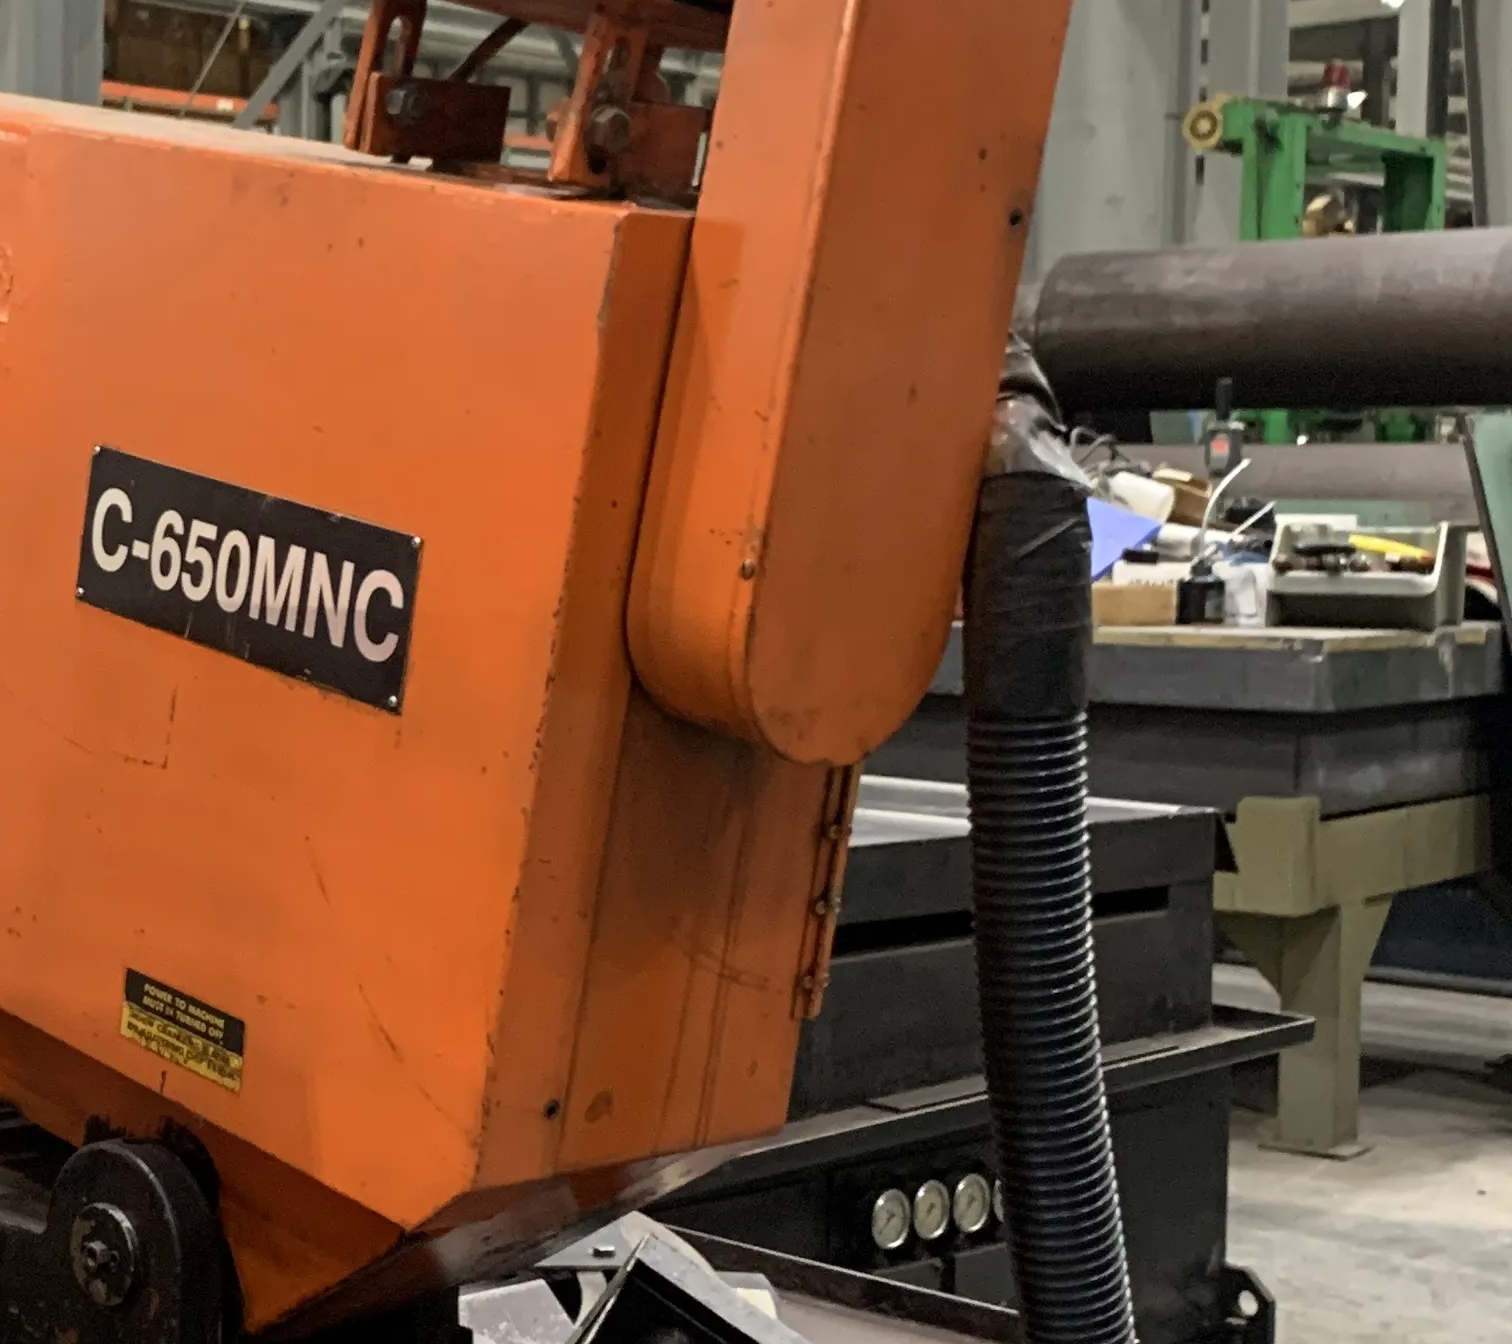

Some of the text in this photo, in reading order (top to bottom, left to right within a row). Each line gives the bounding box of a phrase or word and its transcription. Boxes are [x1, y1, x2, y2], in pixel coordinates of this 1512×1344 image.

[91, 487, 405, 663] C-650MNC
[143, 983, 225, 1029] POWER TO MACHINE
[175, 1010, 207, 1033] TURNED
